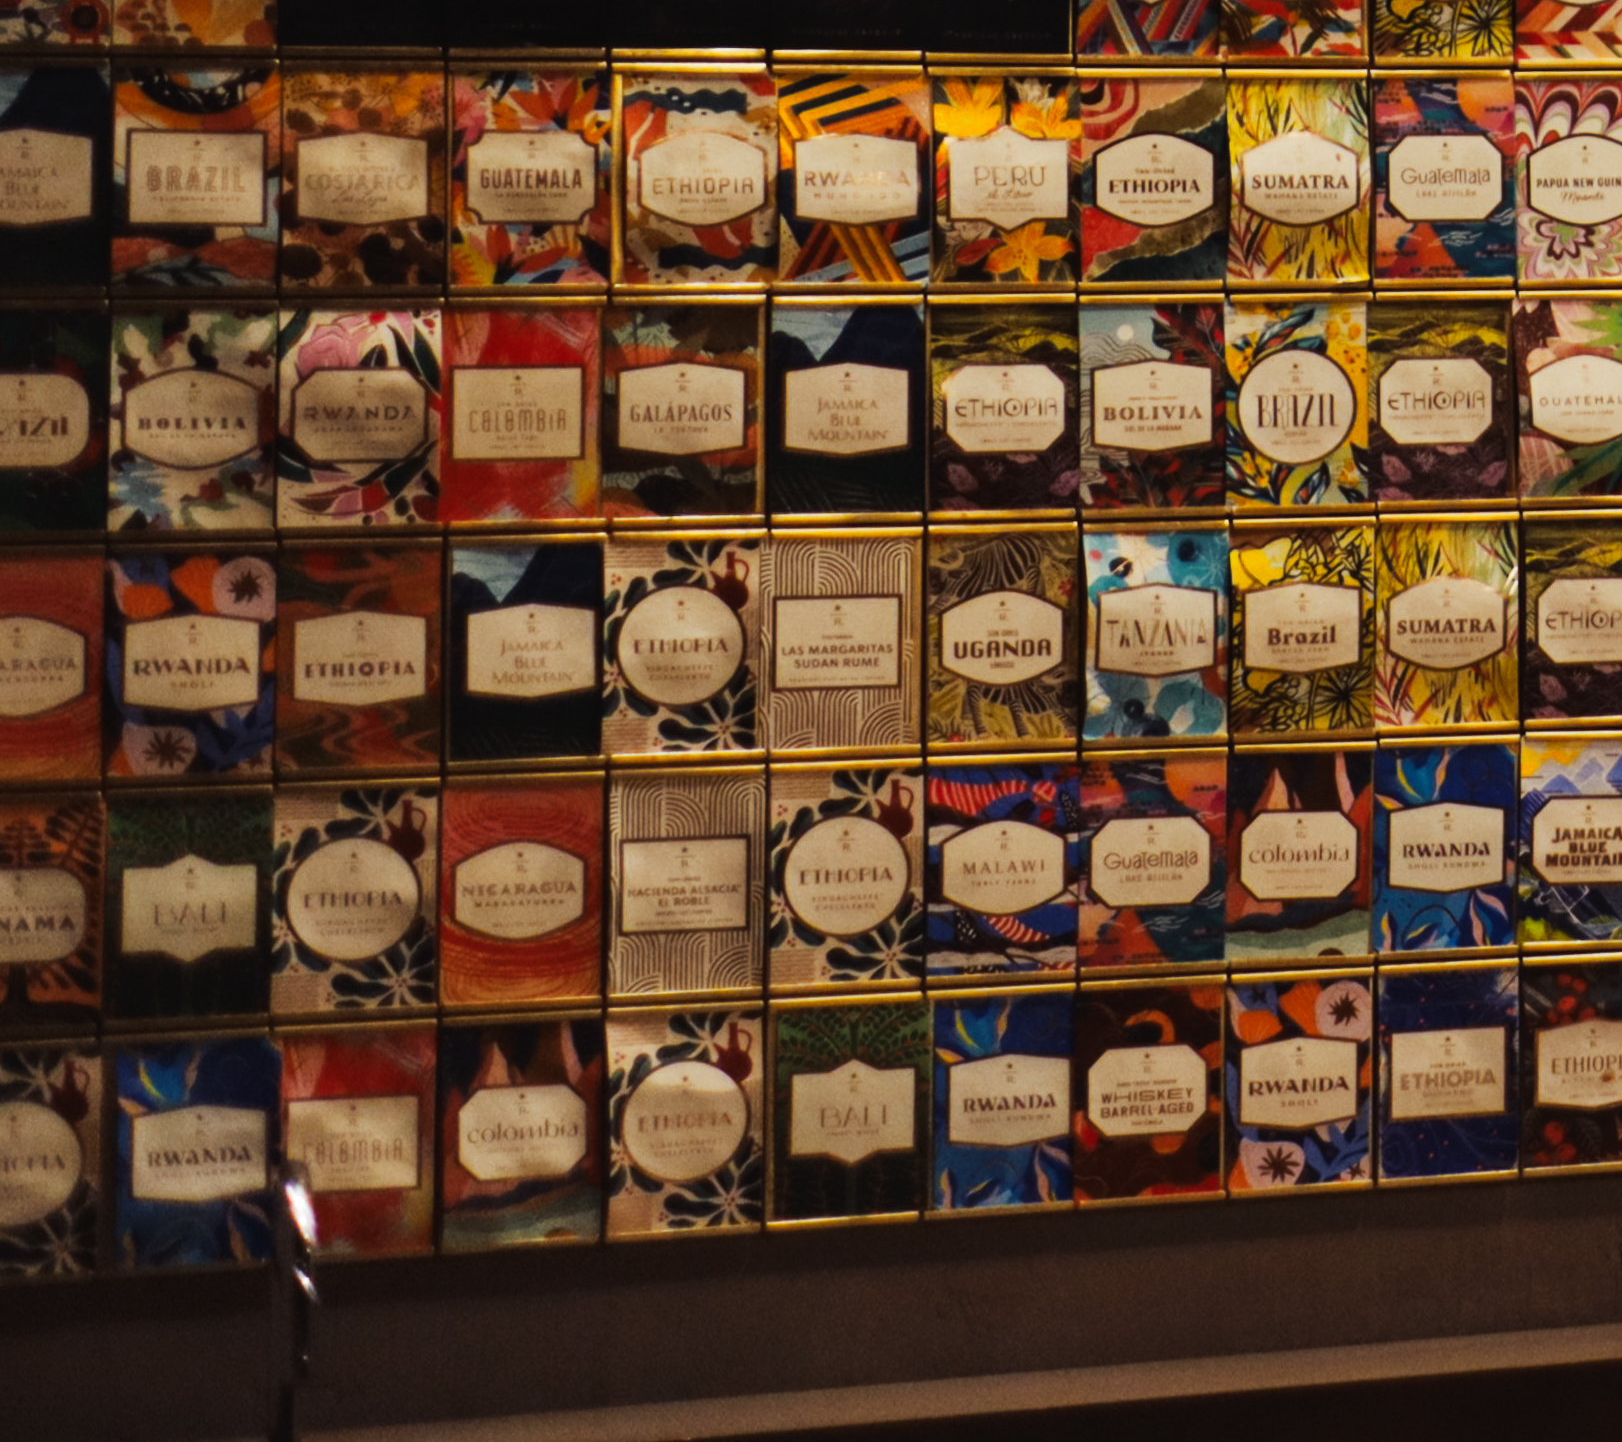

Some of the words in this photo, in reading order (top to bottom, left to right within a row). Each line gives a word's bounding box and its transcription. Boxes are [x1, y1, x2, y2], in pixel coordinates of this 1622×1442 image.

[144, 165, 244, 193] BRAZIL
[480, 169, 582, 191] GUATEMALA
[1252, 175, 1348, 190] SUMATRA
[1401, 168, 1491, 185] Guatemala
[1537, 178, 1569, 188] PAPUA
[1573, 179, 1593, 187] NEW
[1109, 179, 1200, 193] ETHIOPIA
[630, 405, 731, 423] GALÁPAGOS
[1104, 406, 1202, 421] BOLIVIA
[139, 413, 252, 432] BOLIVIA
[1397, 619, 1496, 635] SUMATRA
[1268, 625, 1336, 646] Brazil
[634, 638, 734, 659] ETHIOPIA
[782, 646, 804, 656] LAS
[809, 644, 893, 654] MARGARITAS
[954, 639, 1051, 659] UGANDA
[133, 658, 249, 676] RWANDA
[305, 662, 415, 678] ETHIOPIA
[794, 658, 839, 669] SUDAN
[843, 657, 879, 667] RUME
[1552, 827, 1622, 843] JAMAICA
[1249, 844, 1349, 863] colombia
[1403, 842, 1490, 858] RWANDA
[1569, 842, 1605, 854] BLUE
[962, 860, 1044, 875] MALAWI
[1104, 851, 1198, 870] Guatemala
[462, 879, 577, 897] NICARAGUA
[628, 887, 686, 897] HACIENDA
[691, 884, 741, 897] ALSACIA
[658, 899, 668, 908] EL
[674, 896, 708, 906] ROBLE
[1249, 1076, 1349, 1096] RWANDA
[964, 1094, 1056, 1113] RWANDA
[1101, 1089, 1192, 1104] WHISKEY
[1101, 1102, 1193, 1118] BARREL-AGED
[468, 1117, 581, 1146] colombia
[149, 1143, 258, 1166] RWANDA
